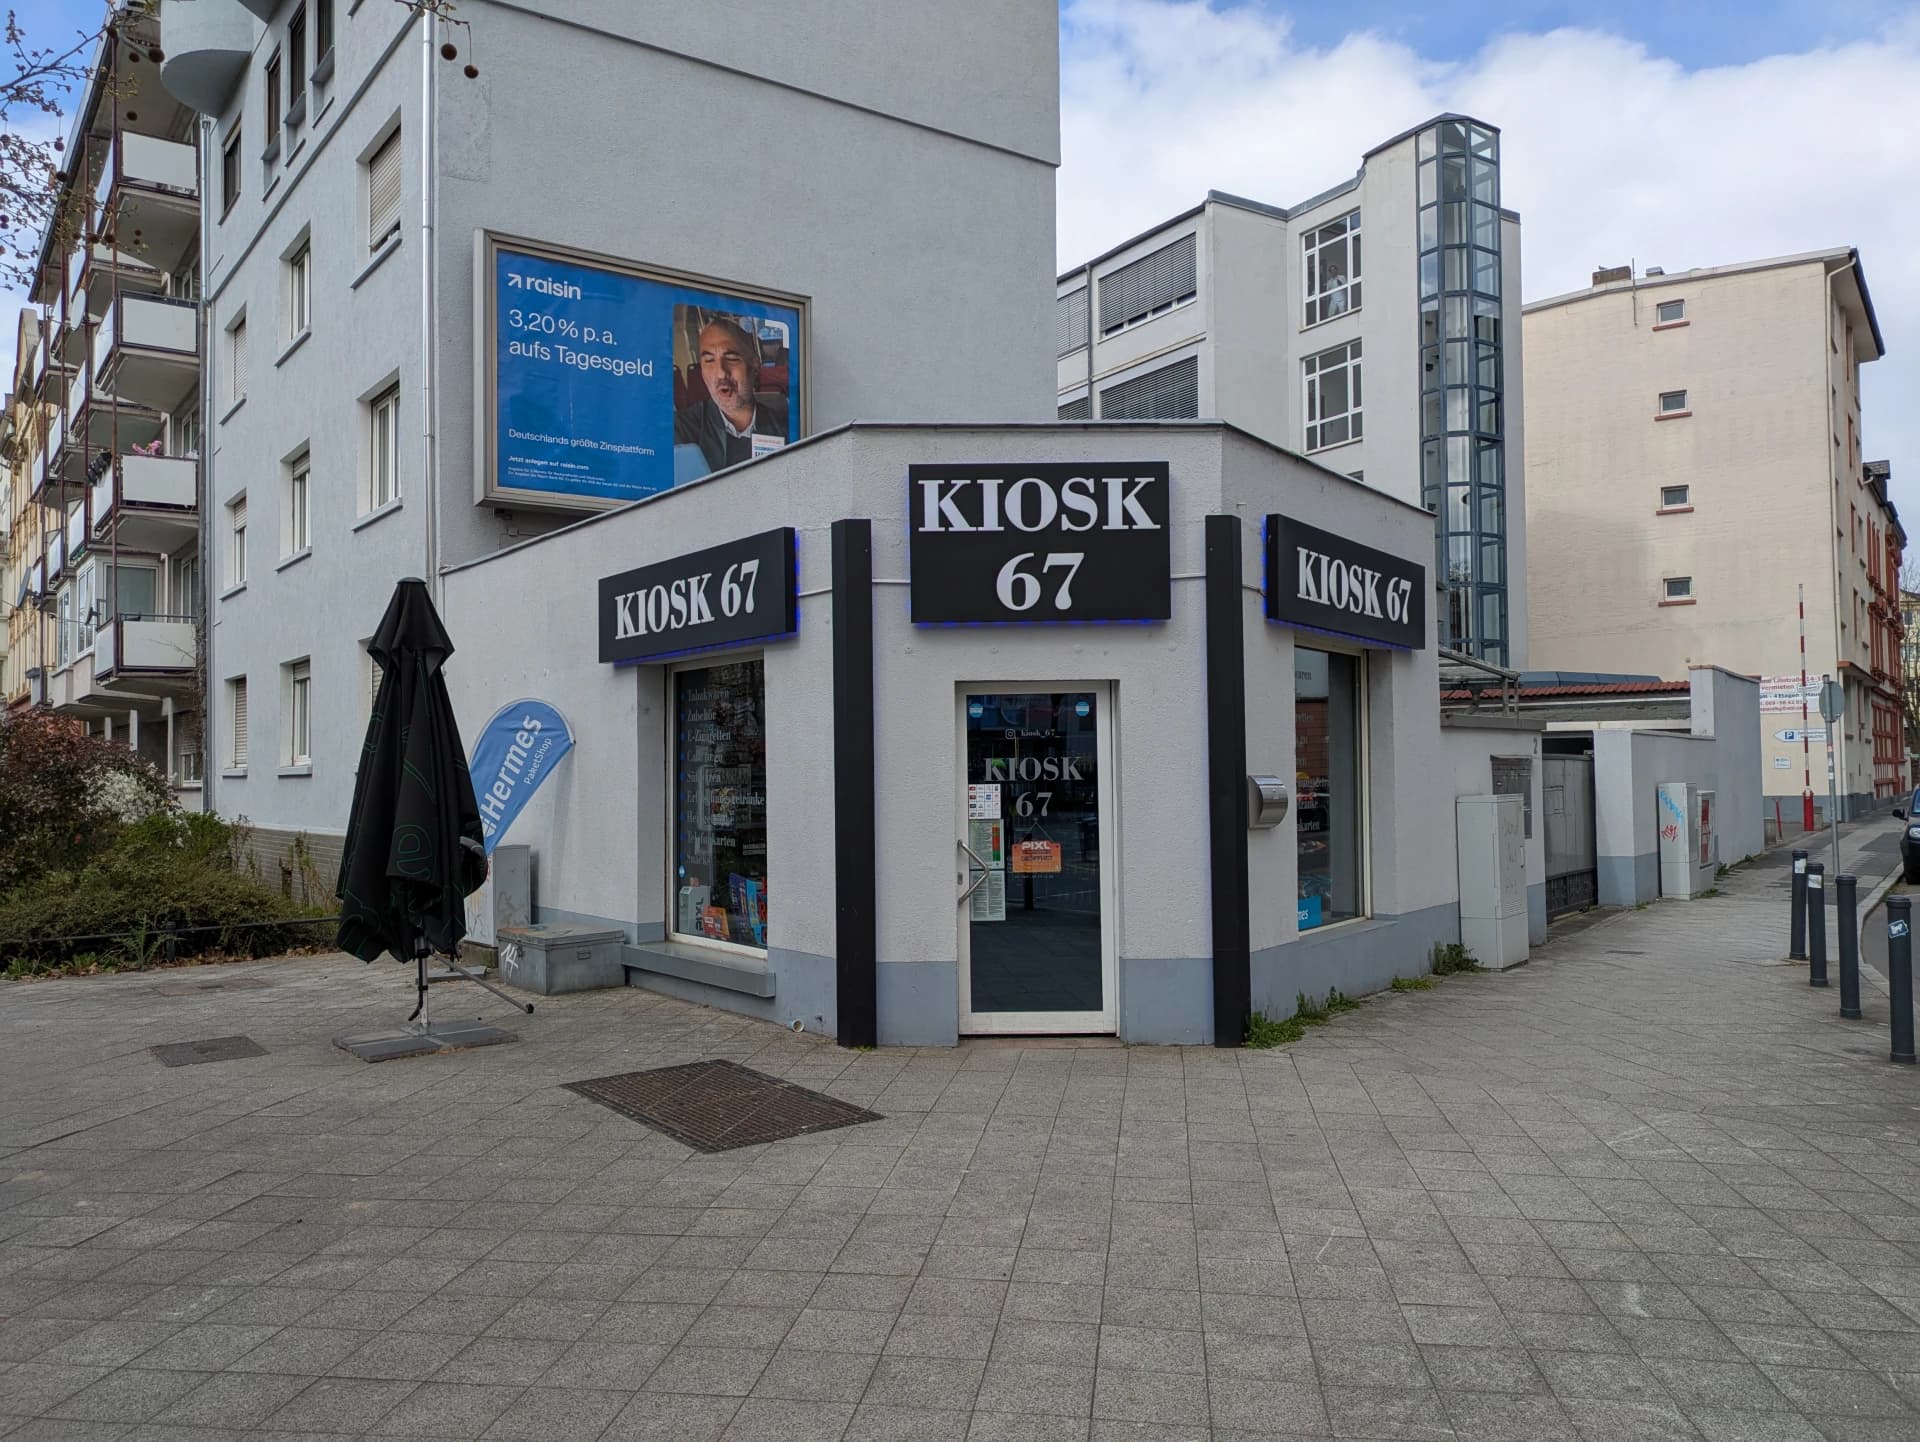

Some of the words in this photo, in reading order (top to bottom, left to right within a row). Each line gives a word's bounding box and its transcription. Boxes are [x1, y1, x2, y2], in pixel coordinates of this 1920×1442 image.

[526, 275, 582, 300] raisin
[508, 340, 551, 361] aufs
[554, 344, 654, 377] Tagesgeld
[508, 428, 569, 446] Deutschlands
[570, 437, 599, 450] größte
[600, 440, 655, 457] Zinsplattform
[919, 478, 1160, 531] KIOSK
[615, 574, 714, 639] KIOSK
[721, 560, 759, 616] 67
[997, 553, 1083, 610] 67
[1298, 547, 1383, 618] KIOSK
[1387, 577, 1411, 625] 67
[480, 715, 542, 821] Hermes
[523, 737, 553, 785] PaketShop
[983, 756, 1085, 782] KIOSK
[1015, 791, 1053, 818] 67
[1021, 841, 1051, 850] PIXL
